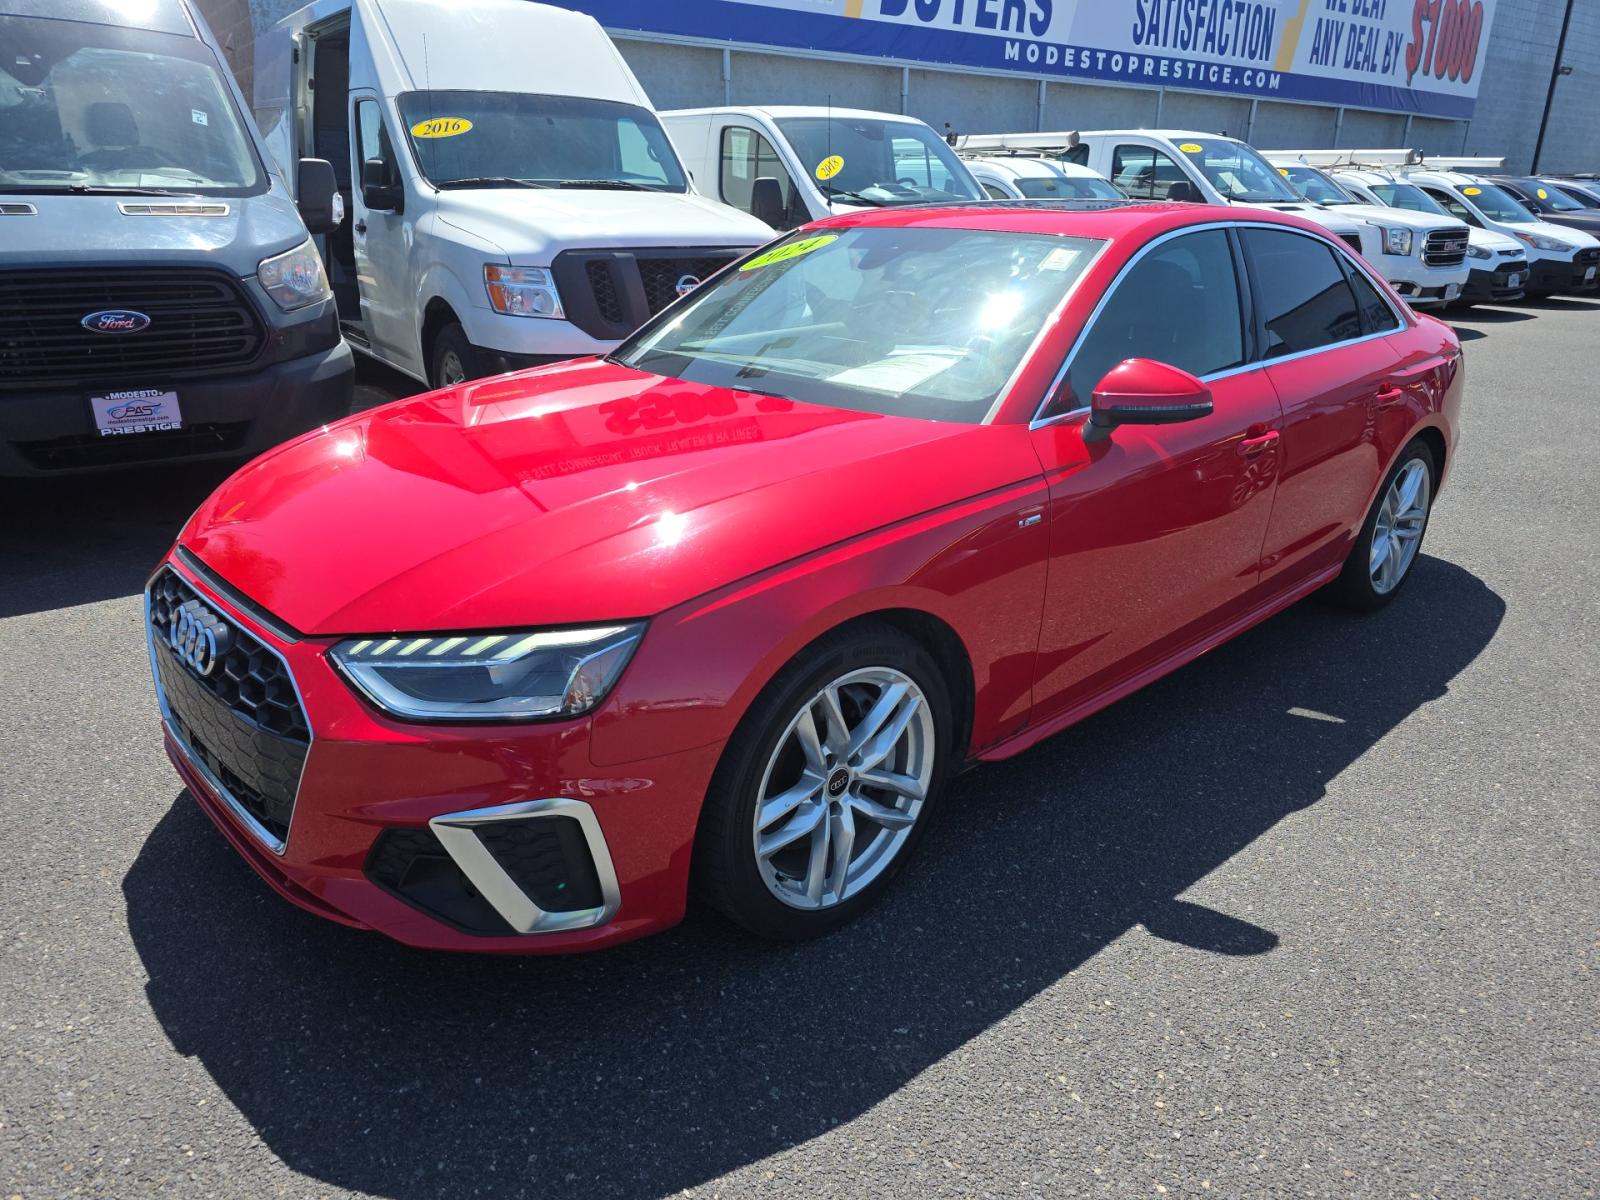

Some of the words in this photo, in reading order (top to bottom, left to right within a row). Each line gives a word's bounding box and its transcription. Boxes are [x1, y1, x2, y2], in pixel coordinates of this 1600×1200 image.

[1132, 0, 1276, 61] SATISFACTION
[1309, 17, 1345, 67] ANY
[1343, 24, 1380, 74] DEAL
[1381, 30, 1404, 76] BY
[1405, 0, 1483, 86] $1000
[1005, 41, 1281, 90] MODESTOPRESTIGE.COM
[423, 121, 460, 136] 2016
[98, 315, 134, 329] Ford
[101, 422, 181, 436] PRESTIGE
